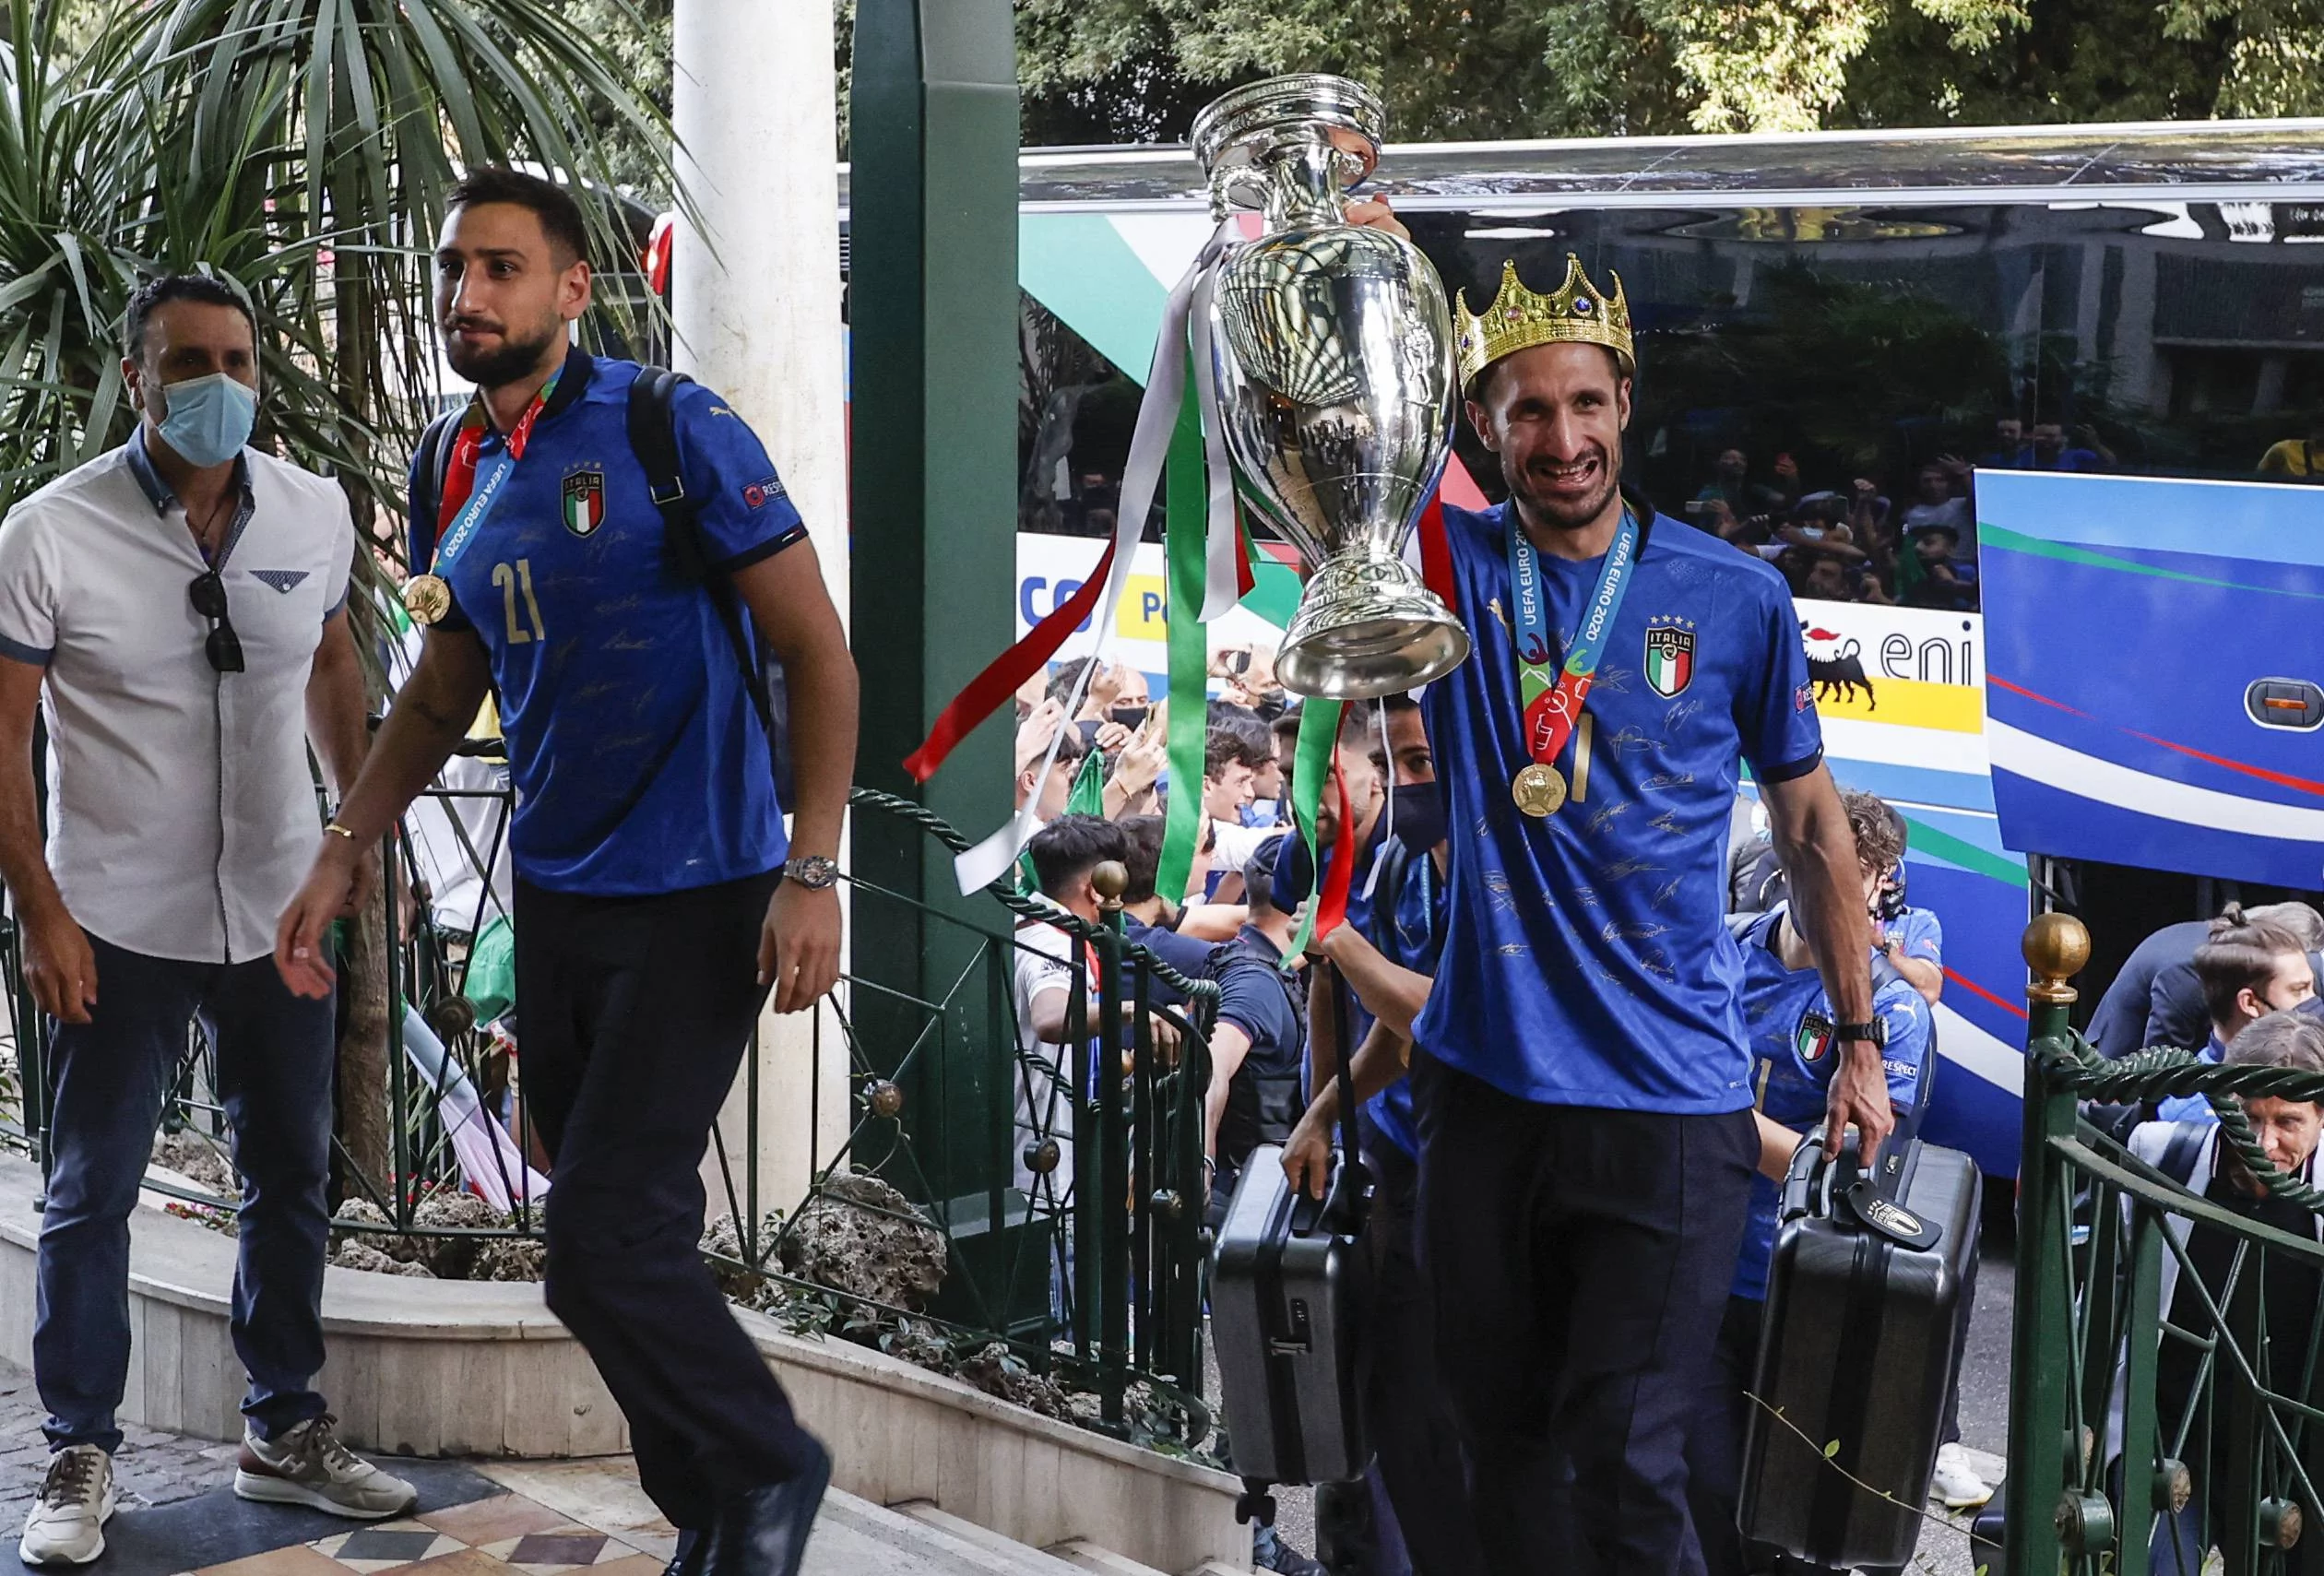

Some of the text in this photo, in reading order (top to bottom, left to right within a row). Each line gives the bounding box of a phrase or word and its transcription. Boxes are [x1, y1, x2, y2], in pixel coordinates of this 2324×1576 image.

[445, 463, 506, 558] UEFA EURO 2020
[1517, 548, 1533, 587] EURO
[1586, 532, 1631, 641] UEFA EURO 2020
[492, 559, 545, 644] 21
[1522, 587, 1536, 625] UEFA
[1651, 632, 1690, 646] ITALIA
[1880, 620, 1971, 686] eni
[1882, 1060, 1917, 1076] RESPECT
